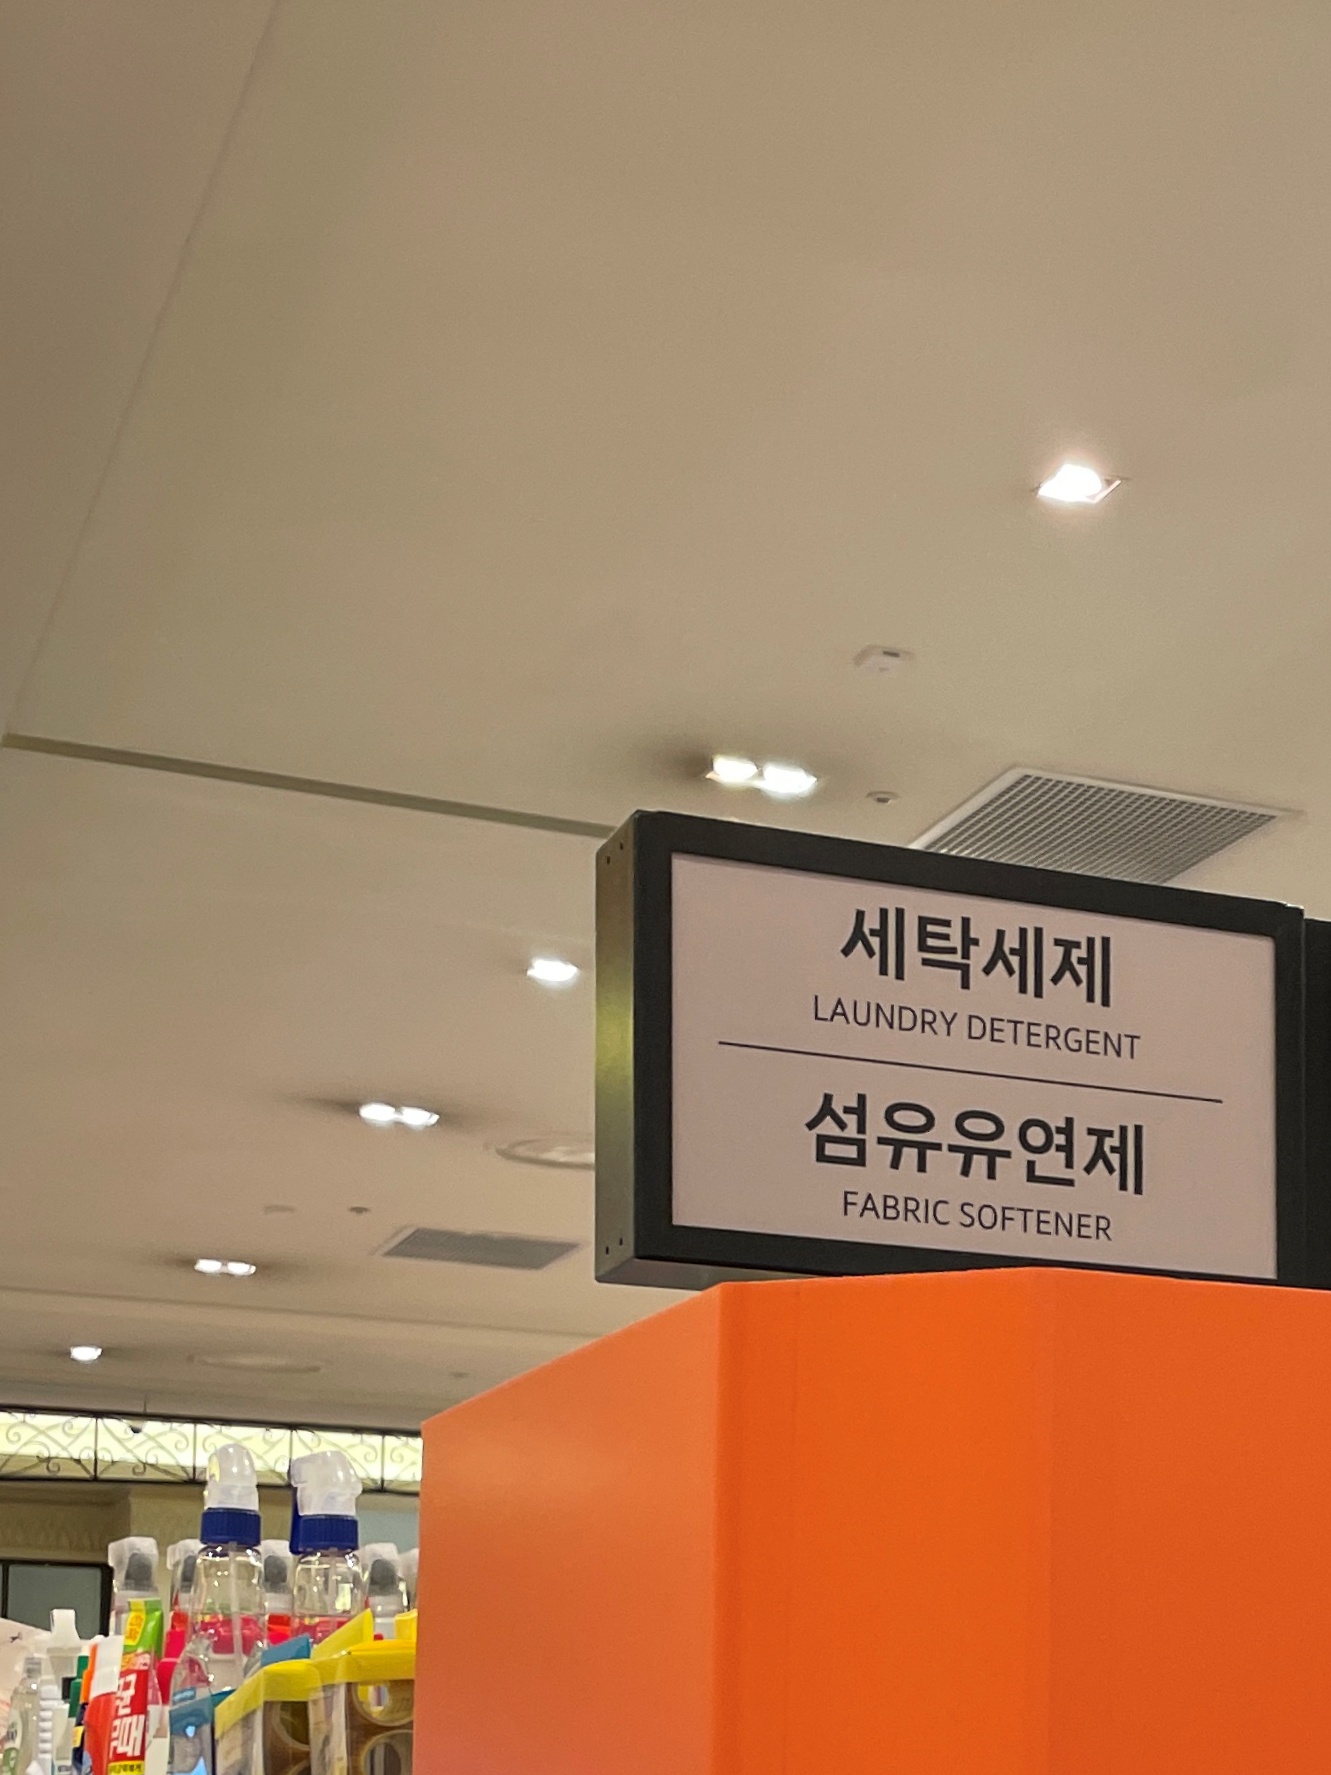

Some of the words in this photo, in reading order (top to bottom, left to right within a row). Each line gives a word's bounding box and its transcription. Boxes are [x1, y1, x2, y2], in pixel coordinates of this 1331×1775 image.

[840, 903, 1112, 1008] 세탁세제
[812, 994, 959, 1041] LAUNDRY
[965, 1012, 1140, 1060] DETERGENT
[804, 1090, 1146, 1196] 섬유유연제
[842, 1190, 951, 1230] FABRIC
[959, 1200, 1112, 1241] SOFTENER
